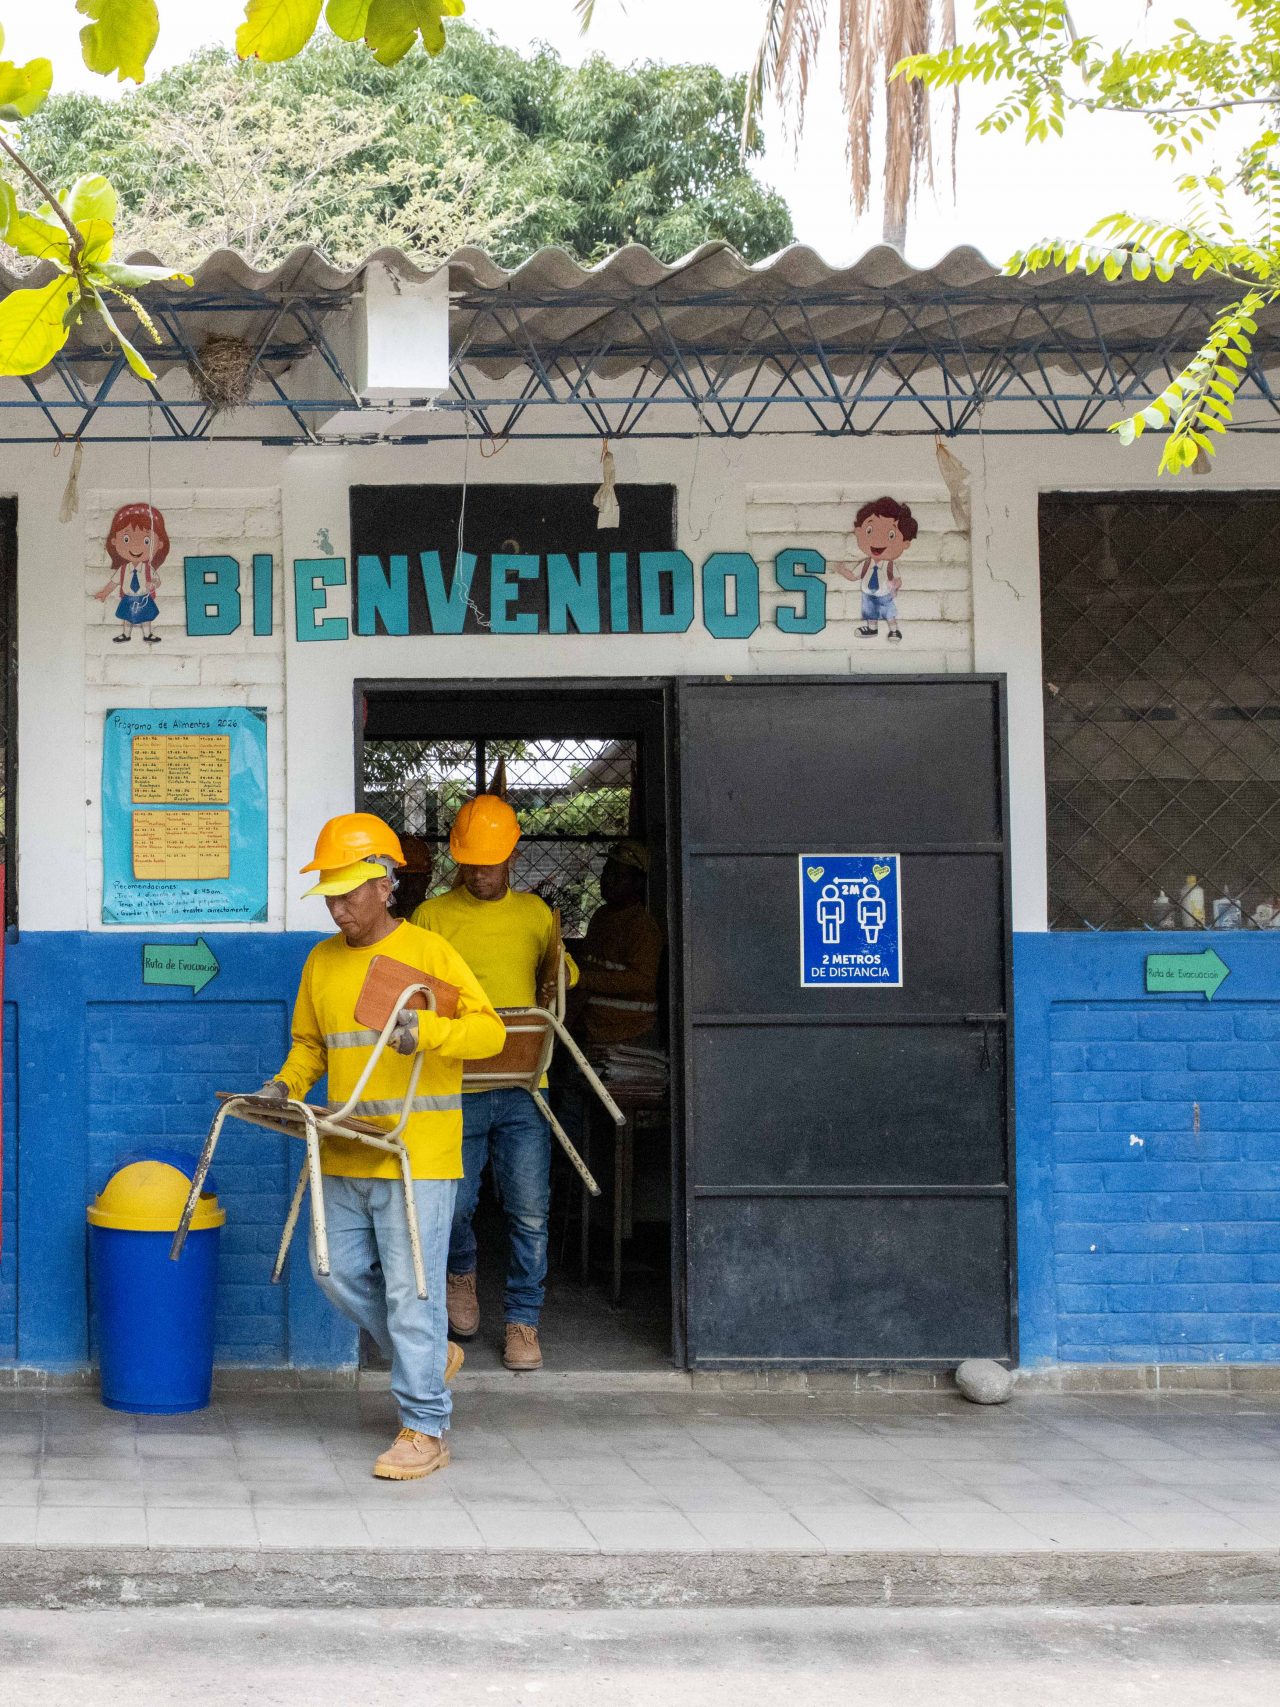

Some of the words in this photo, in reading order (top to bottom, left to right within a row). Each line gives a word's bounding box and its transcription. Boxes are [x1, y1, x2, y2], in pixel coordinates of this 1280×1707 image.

[183, 548, 828, 642] BIENVENIDOS
[114, 715, 152, 735] Programa
[158, 721, 168, 729] de
[841, 885, 860, 896] 2M
[145, 957, 163, 970] Ruta
[166, 959, 176, 970] de
[822, 955, 830, 965] 2
[832, 954, 881, 965] METROS
[811, 967, 826, 977] DE
[829, 967, 890, 977] DISTANCIA
[1166, 968, 1175, 978] de
